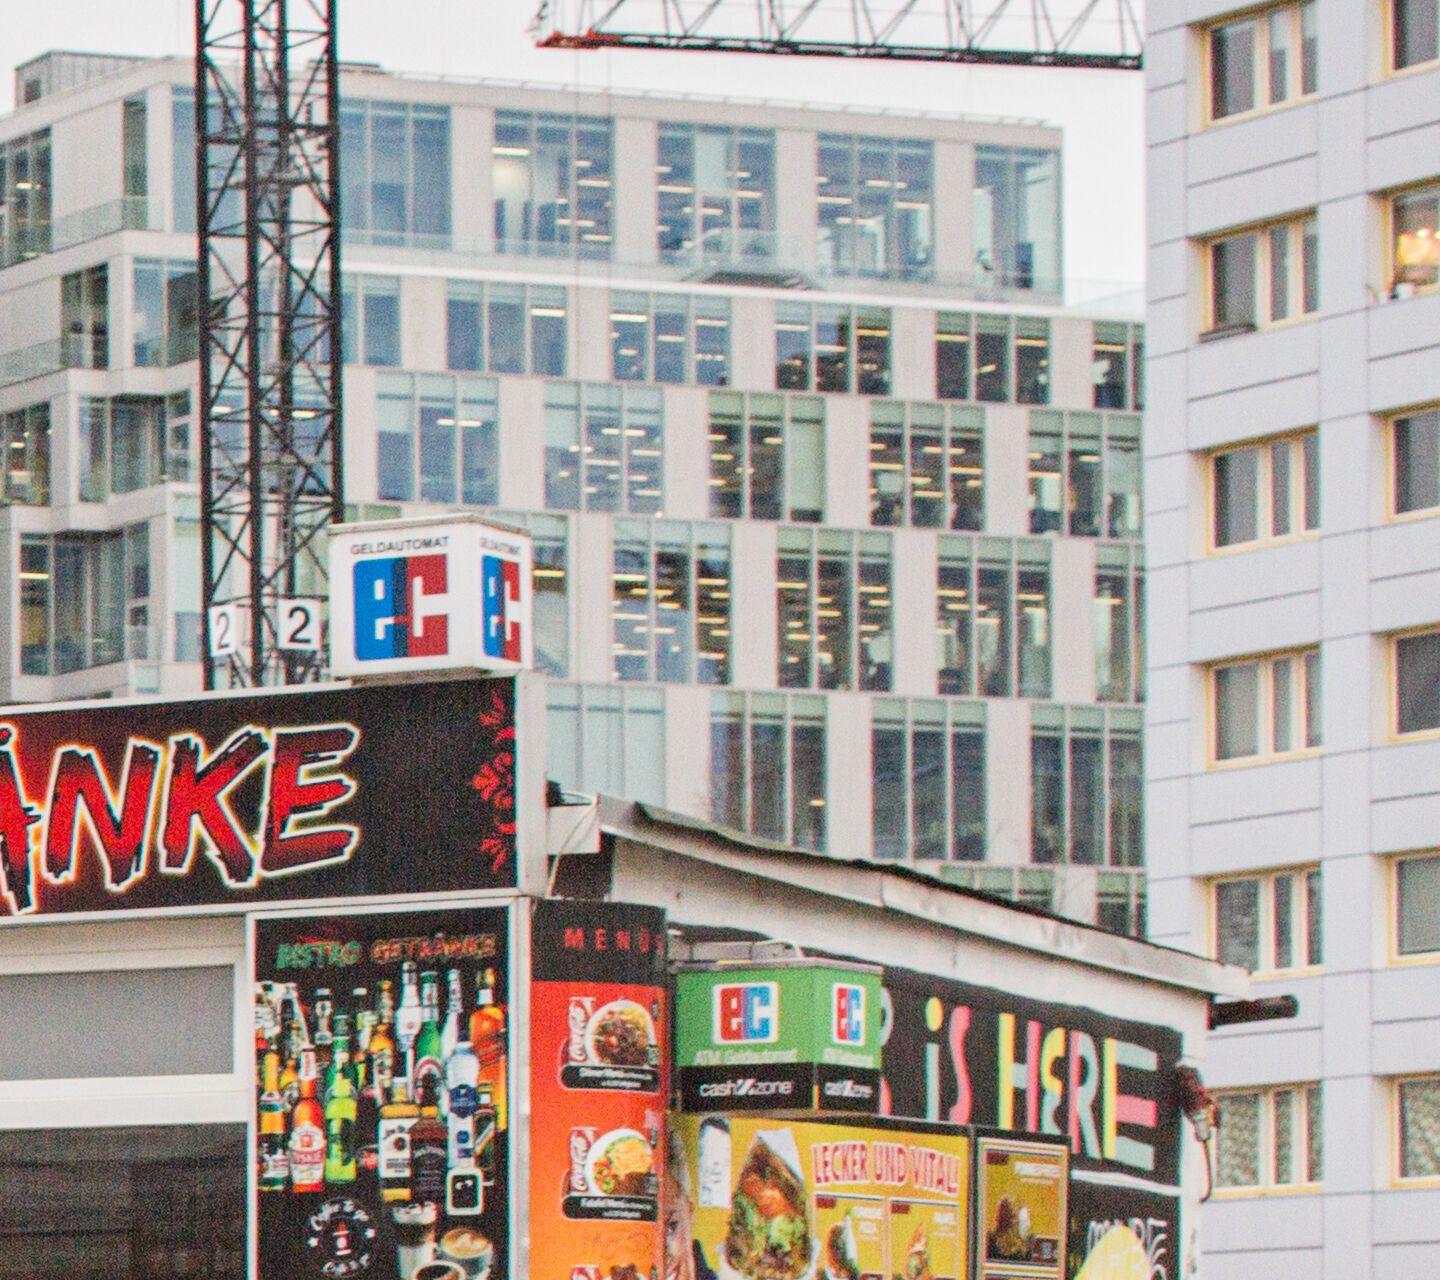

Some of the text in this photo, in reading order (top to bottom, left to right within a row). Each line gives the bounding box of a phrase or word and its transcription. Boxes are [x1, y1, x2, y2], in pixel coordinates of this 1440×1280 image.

[350, 536, 449, 555] GELDAUTOMAT
[216, 605, 311, 650] 2 2
[276, 941, 360, 968] BISTRO
[812, 1140, 870, 1186] LECKER
[873, 1140, 908, 1186] UND
[909, 1146, 961, 1197] VITAL!
